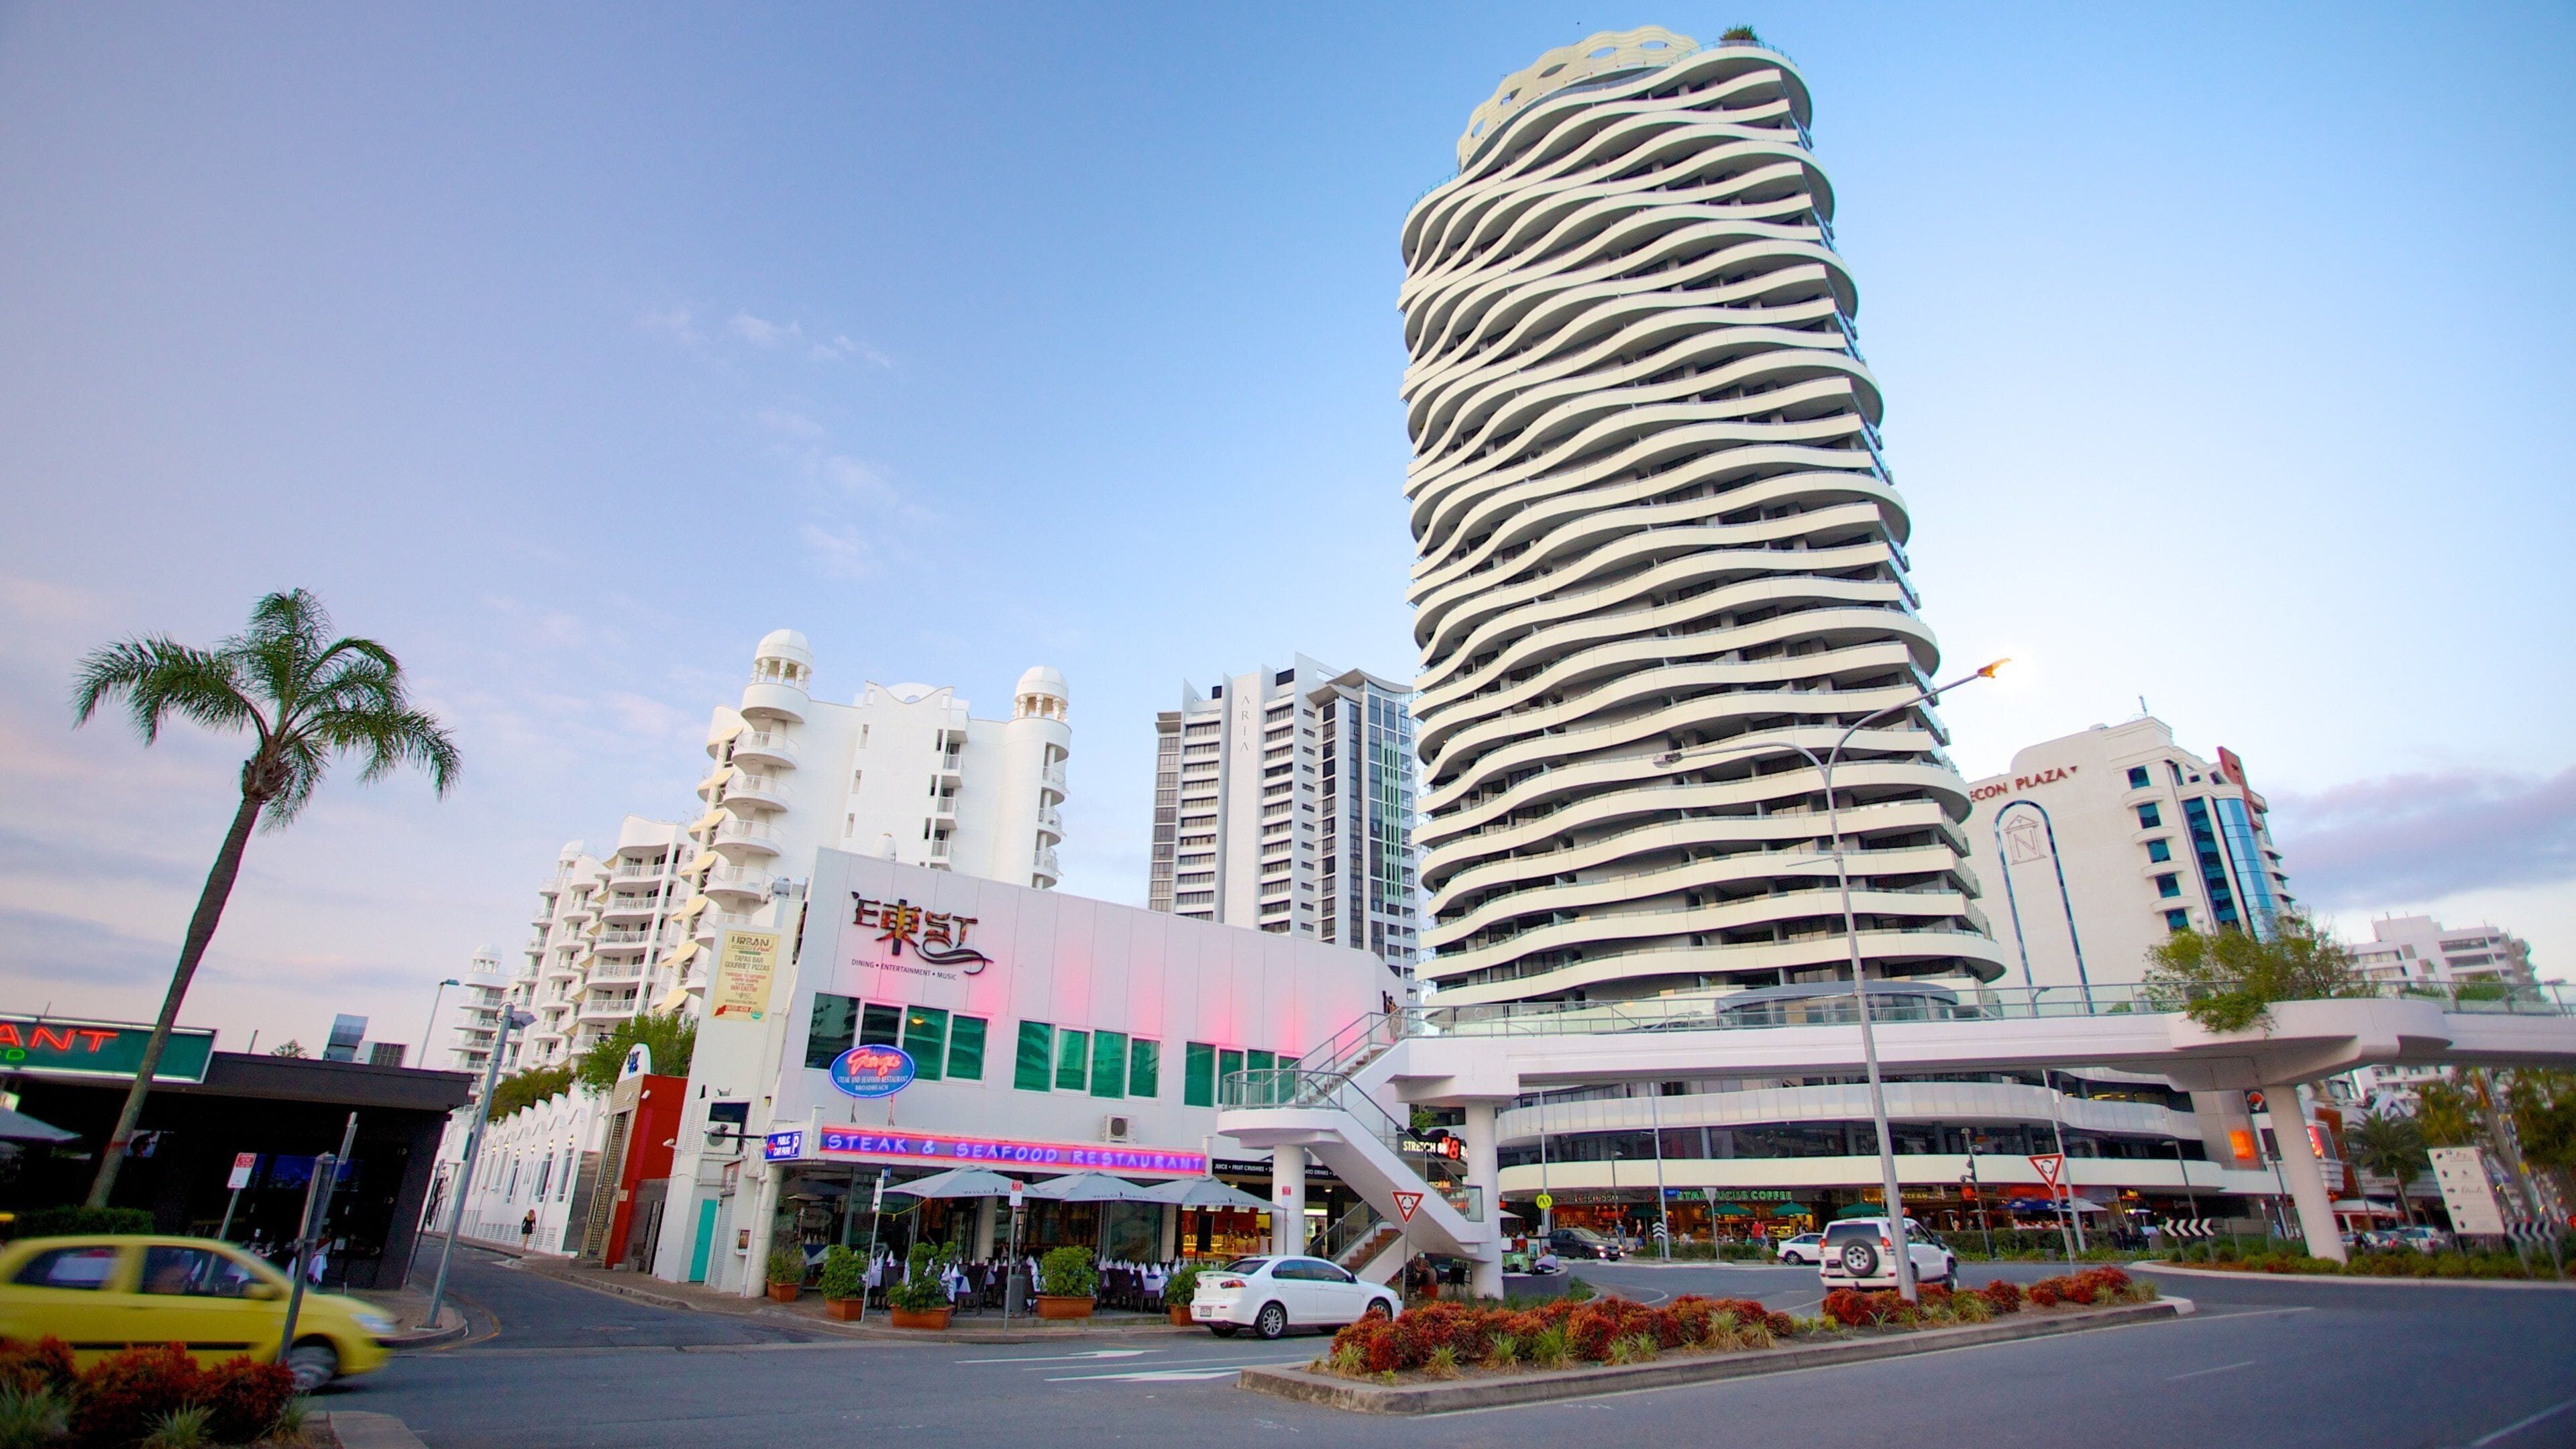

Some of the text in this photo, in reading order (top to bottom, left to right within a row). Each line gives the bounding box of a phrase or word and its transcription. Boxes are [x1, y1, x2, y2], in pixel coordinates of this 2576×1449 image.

[1240, 696, 1250, 753] ARIA
[2015, 767, 2068, 790] PLAZA
[731, 936, 769, 947] URBAN
[725, 961, 770, 971] GOURMET PIZZAS
[851, 959, 957, 980] DINING ENTERTAINMENT MUSIC
[777, 1135, 791, 1145] PUBLIC
[792, 1135, 799, 1154] P
[1403, 1140, 1436, 1152] STRETCH
[1437, 1142, 1448, 1154] 88
[773, 1146, 791, 1156] CAR PARK
[827, 1134, 1202, 1169] STEAK & SEAFOOD RESTAURANT
[1677, 1191, 1748, 1199] STARUCKS
[1750, 1191, 1792, 1200] COFFEE
